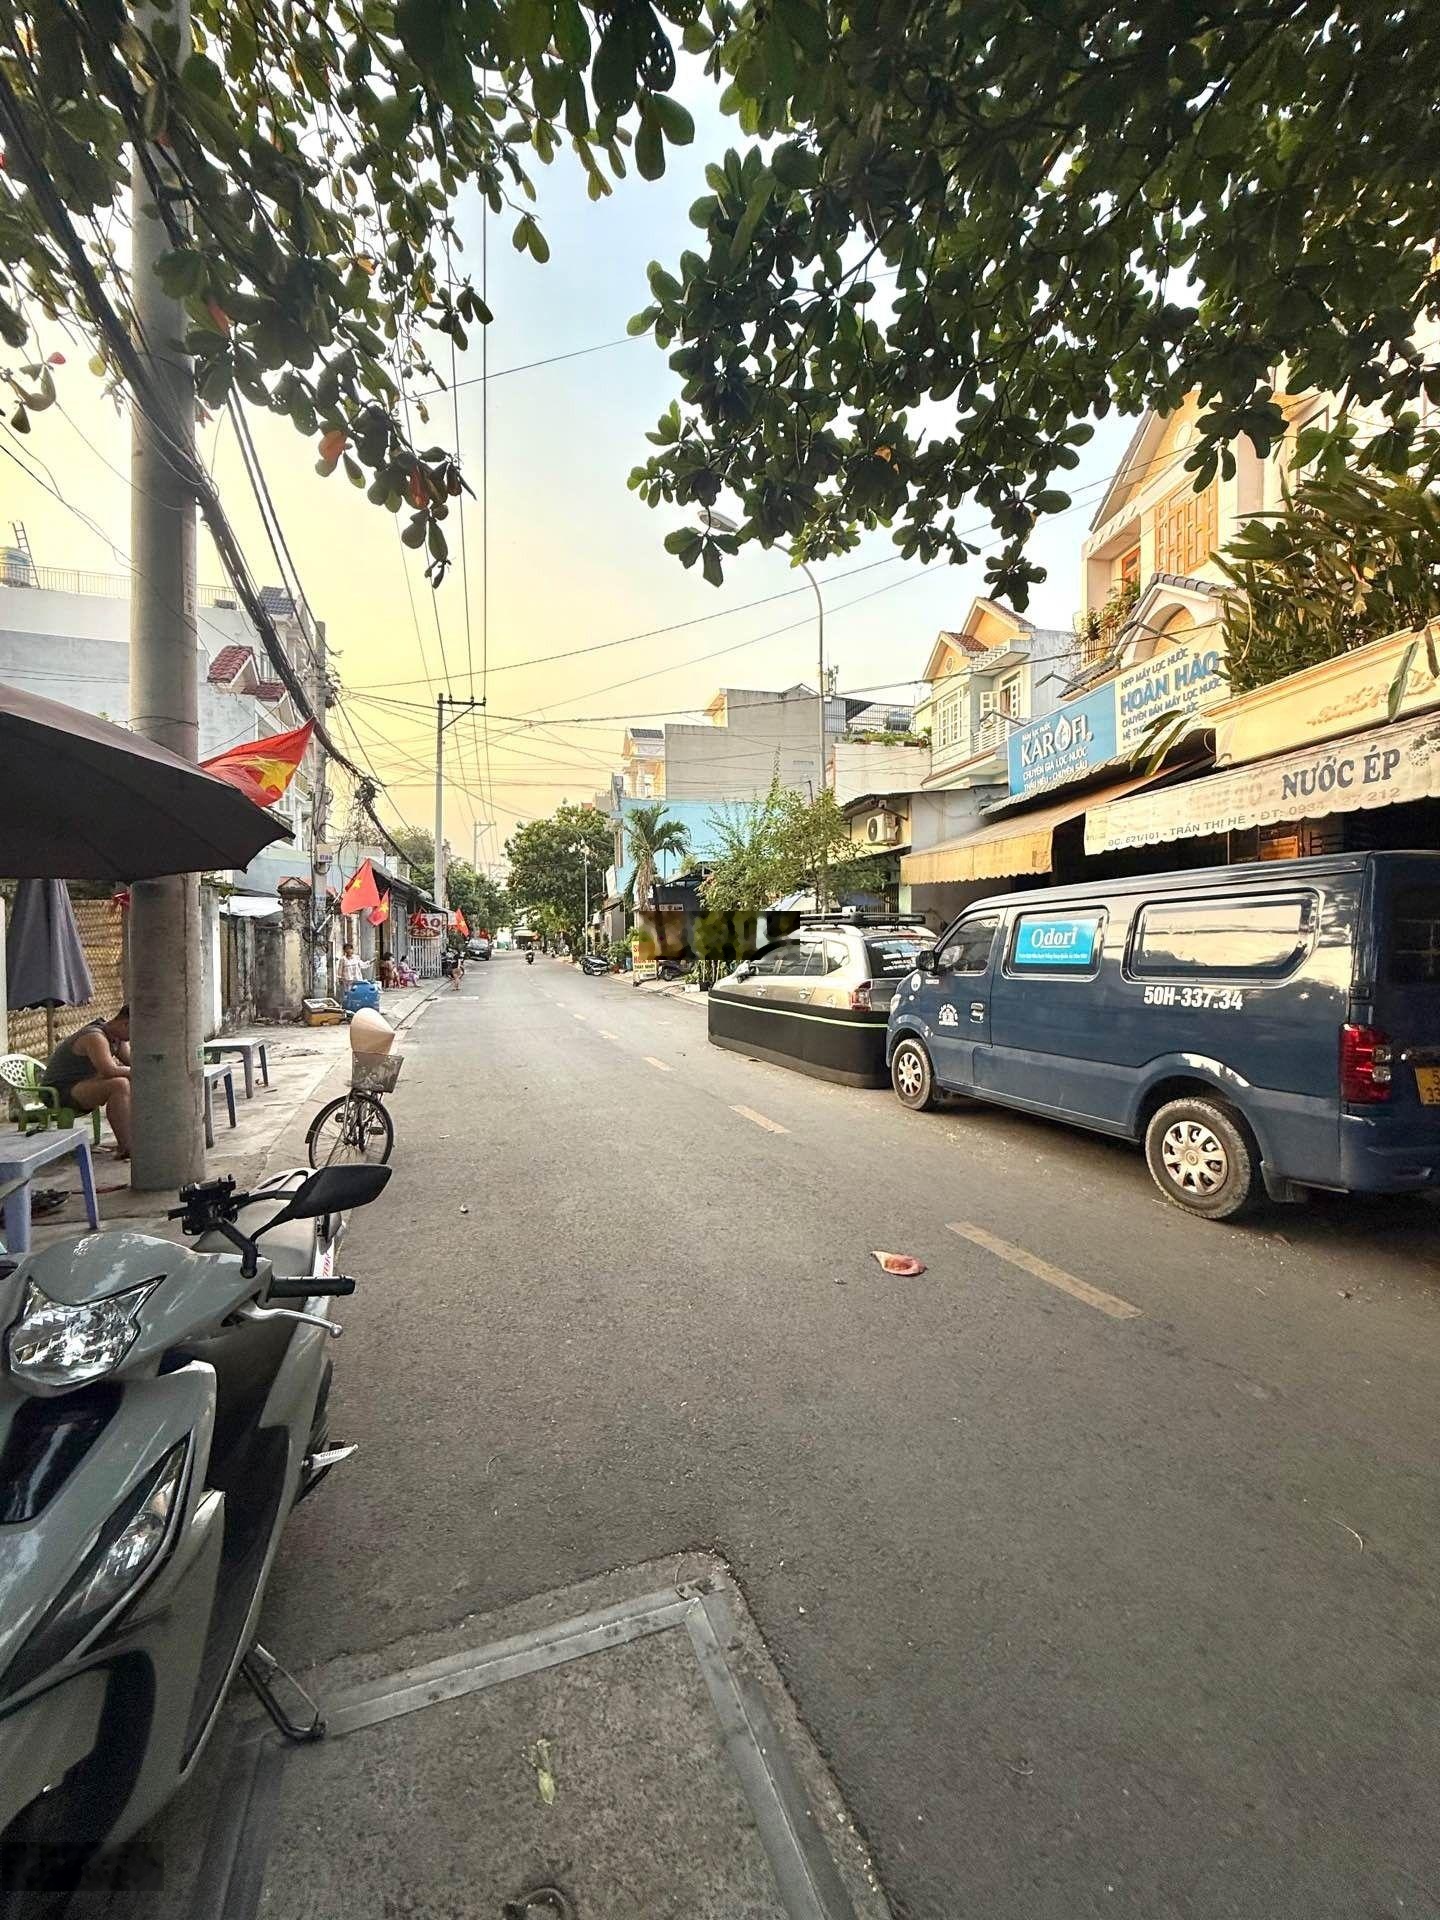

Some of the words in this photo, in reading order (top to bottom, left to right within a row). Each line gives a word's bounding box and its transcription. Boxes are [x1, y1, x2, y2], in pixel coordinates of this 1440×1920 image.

[1120, 673, 1170, 716] HOÀN
[1174, 650, 1220, 691] HẢO
[1021, 715, 1088, 767] KAROFI
[1281, 754, 1355, 800] NƯỚC
[1362, 744, 1401, 784] ÉP
[1031, 926, 1079, 949] Odori
[1143, 985, 1244, 1010] 50H-337.34
